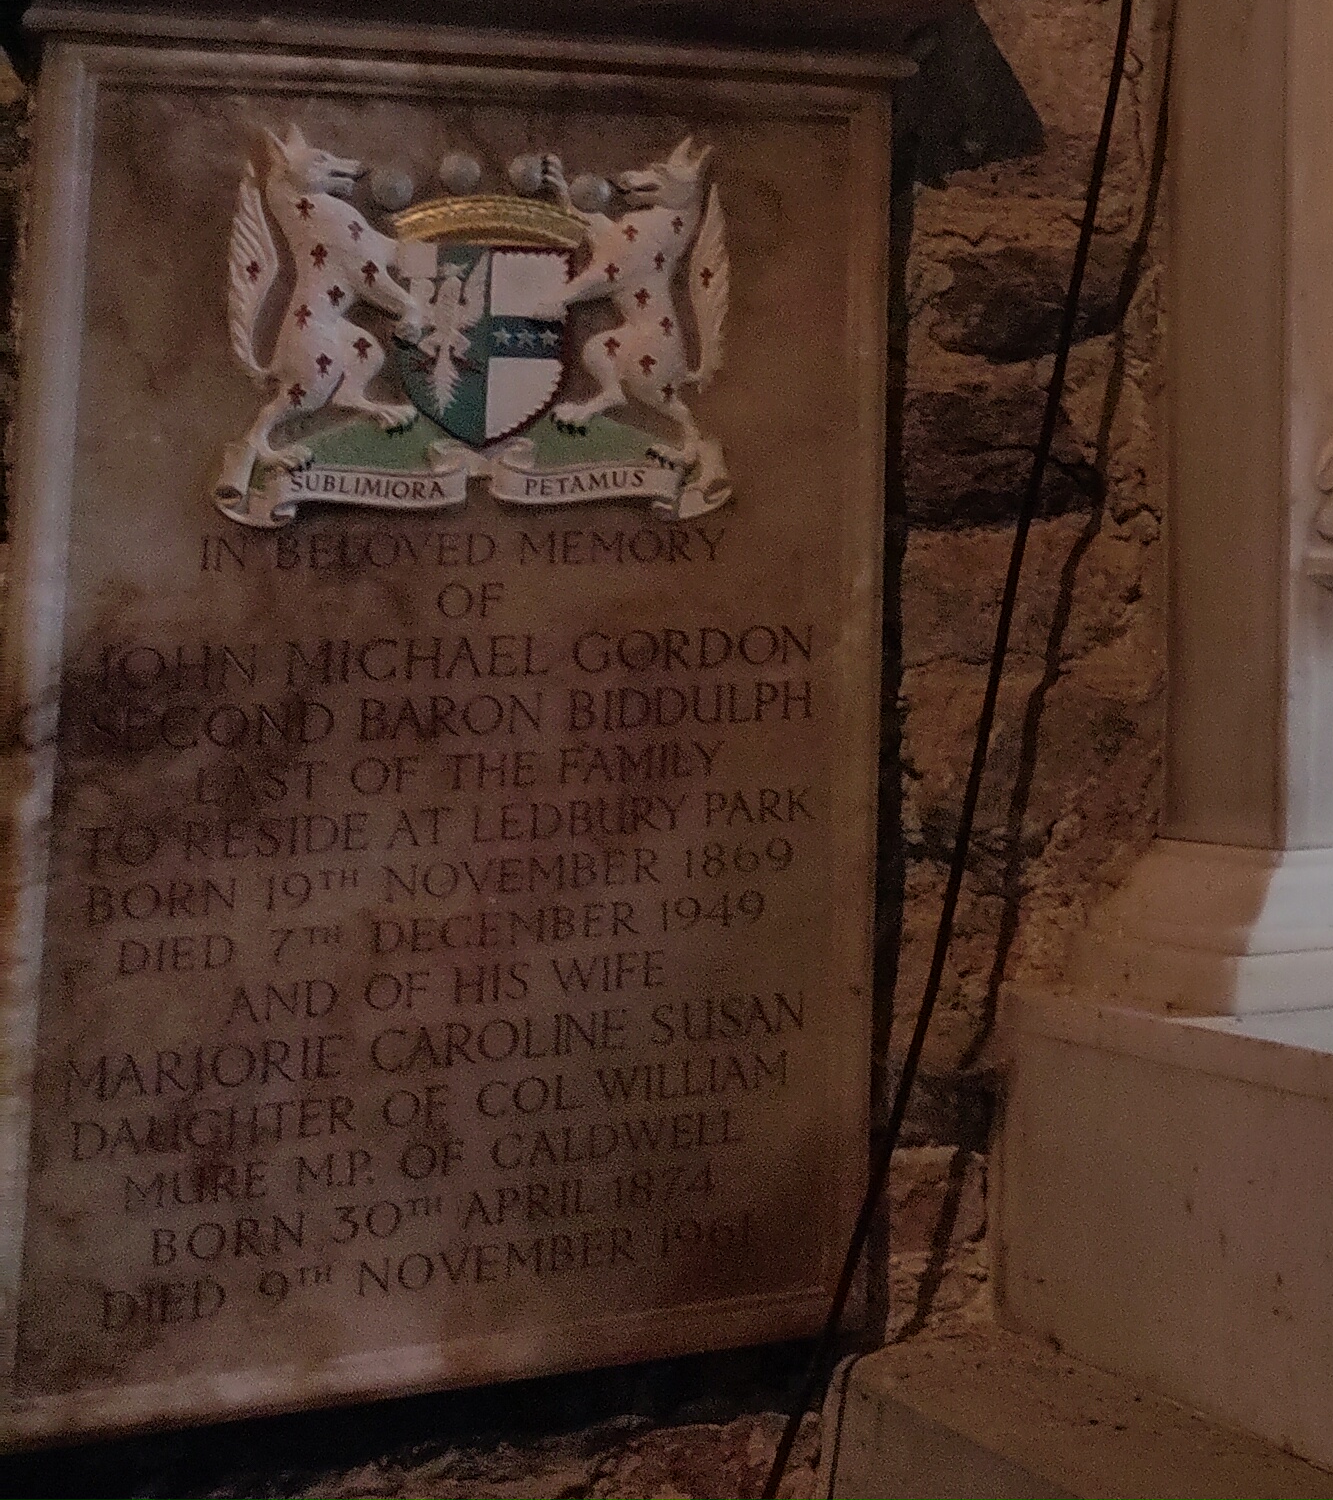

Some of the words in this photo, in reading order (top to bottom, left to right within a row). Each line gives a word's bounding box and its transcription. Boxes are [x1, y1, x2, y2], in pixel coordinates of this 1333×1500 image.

[290, 473, 449, 499] SUBLIMIORA
[525, 470, 646, 496] PETAMUS
[201, 534, 248, 572] IN
[275, 531, 497, 571] BELOVED
[519, 528, 726, 566] MEMORY
[437, 581, 505, 619] OF
[285, 634, 549, 686] MICHAEL
[572, 624, 814, 674] GORDON
[359, 691, 543, 741] BARON
[568, 680, 814, 732] BIDDULPH
[196, 760, 328, 804] LAST
[350, 755, 420, 795] OF
[450, 751, 538, 790] THE
[558, 740, 726, 785] FAMILY
[79, 825, 158, 867] TO
[184, 811, 370, 860] RESIDE
[386, 806, 453, 850] AT
[472, 794, 687, 843] LEDBURY
[704, 787, 817, 828] PARK
[86, 877, 237, 927] BORN
[265, 868, 360, 912] 19TH
[382, 847, 662, 904] NOVEMBER
[683, 837, 794, 880] 1869
[117, 934, 235, 976] DIED
[270, 925, 342, 966] 7TH
[371, 900, 640, 954] DECEMBER
[660, 889, 765, 933] 1949
[225, 978, 339, 1025] AND
[364, 971, 431, 1011] OF
[453, 962, 529, 1005] HIS
[551, 950, 665, 994] WIFE
[66, 1033, 344, 1102] MARJORIE
[370, 1008, 627, 1075] CAROLINE
[650, 990, 804, 1046] SUSAN
[70, 1095, 355, 1162] DAUGHTER
[382, 1083, 449, 1130] OF
[476, 1075, 584, 1118] COL
[594, 1049, 788, 1103] WILLIAM
[123, 1159, 269, 1212] MURE
[400, 1137, 464, 1182] OF
[490, 1109, 743, 1169] CALDWELL
[152, 1211, 305, 1266] BORN
[331, 1196, 442, 1244] 30TH
[463, 1178, 595, 1230] APRIL
[258, 1263, 333, 1307] 9TH
[357, 1226, 635, 1297] NOVEMBER
